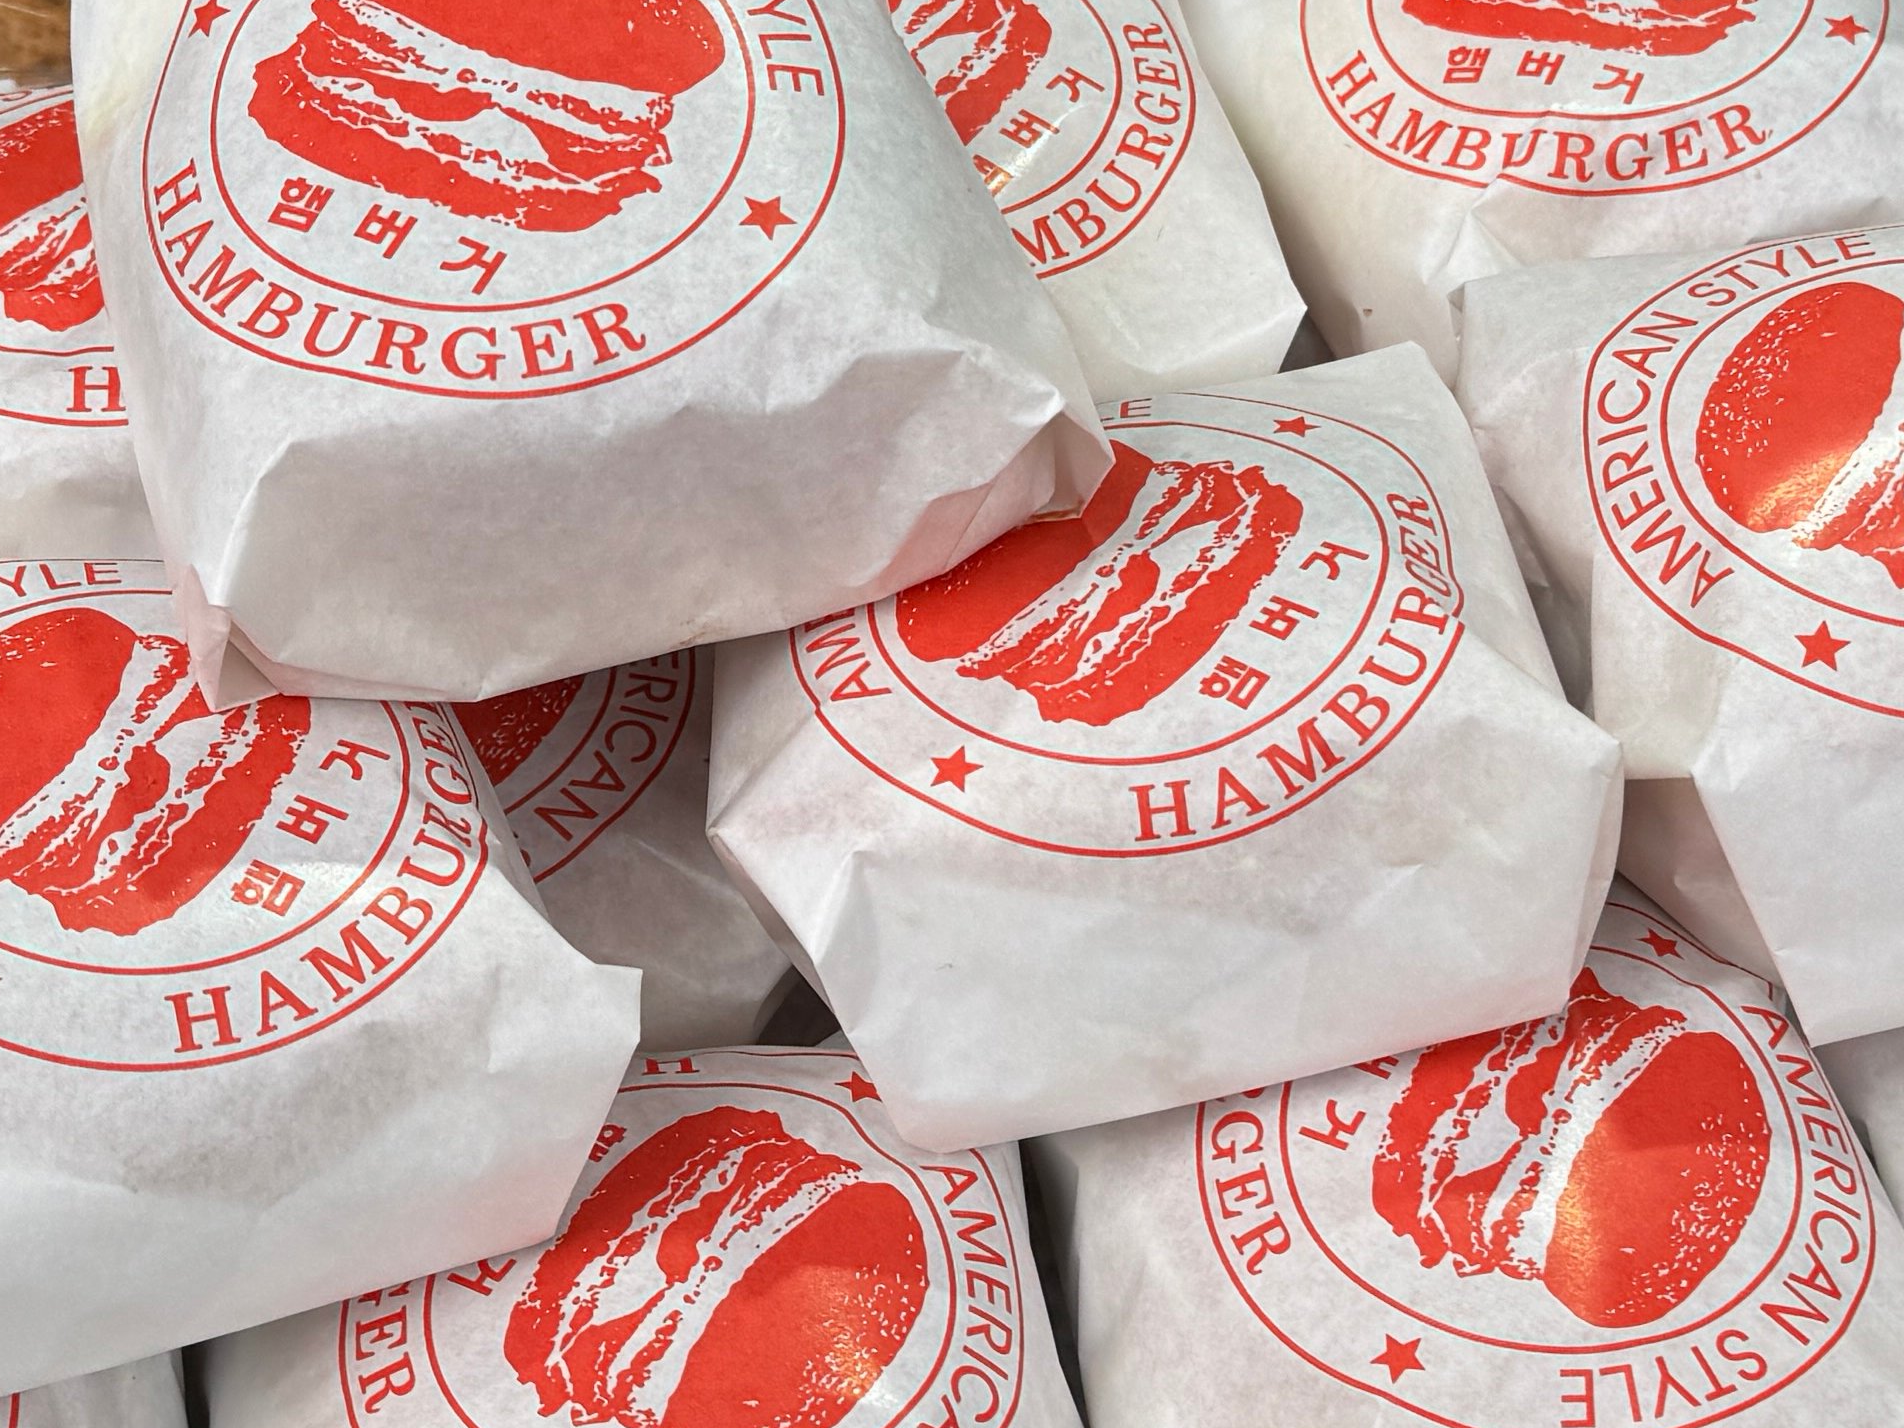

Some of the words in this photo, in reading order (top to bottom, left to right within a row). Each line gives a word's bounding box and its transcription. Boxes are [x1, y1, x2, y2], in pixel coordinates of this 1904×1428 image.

[1010, 22, 1182, 268] MBURGER
[1325, 50, 1768, 184] HAMBURGER
[1441, 45, 1645, 105] 햄버거
[152, 159, 647, 382] HAMBURGER
[267, 175, 509, 298] 햄버거
[1596, 310, 1735, 611] AMERICAN
[1686, 232, 1877, 310] STYLE
[1128, 491, 1453, 842] HAMBURGER
[1198, 540, 1370, 711] 햄버거
[231, 739, 393, 918] 햄버거
[534, 651, 680, 842] RICAN
[163, 702, 474, 1054] HAMBURGE
[1739, 1004, 1862, 1348] AMERICAN
